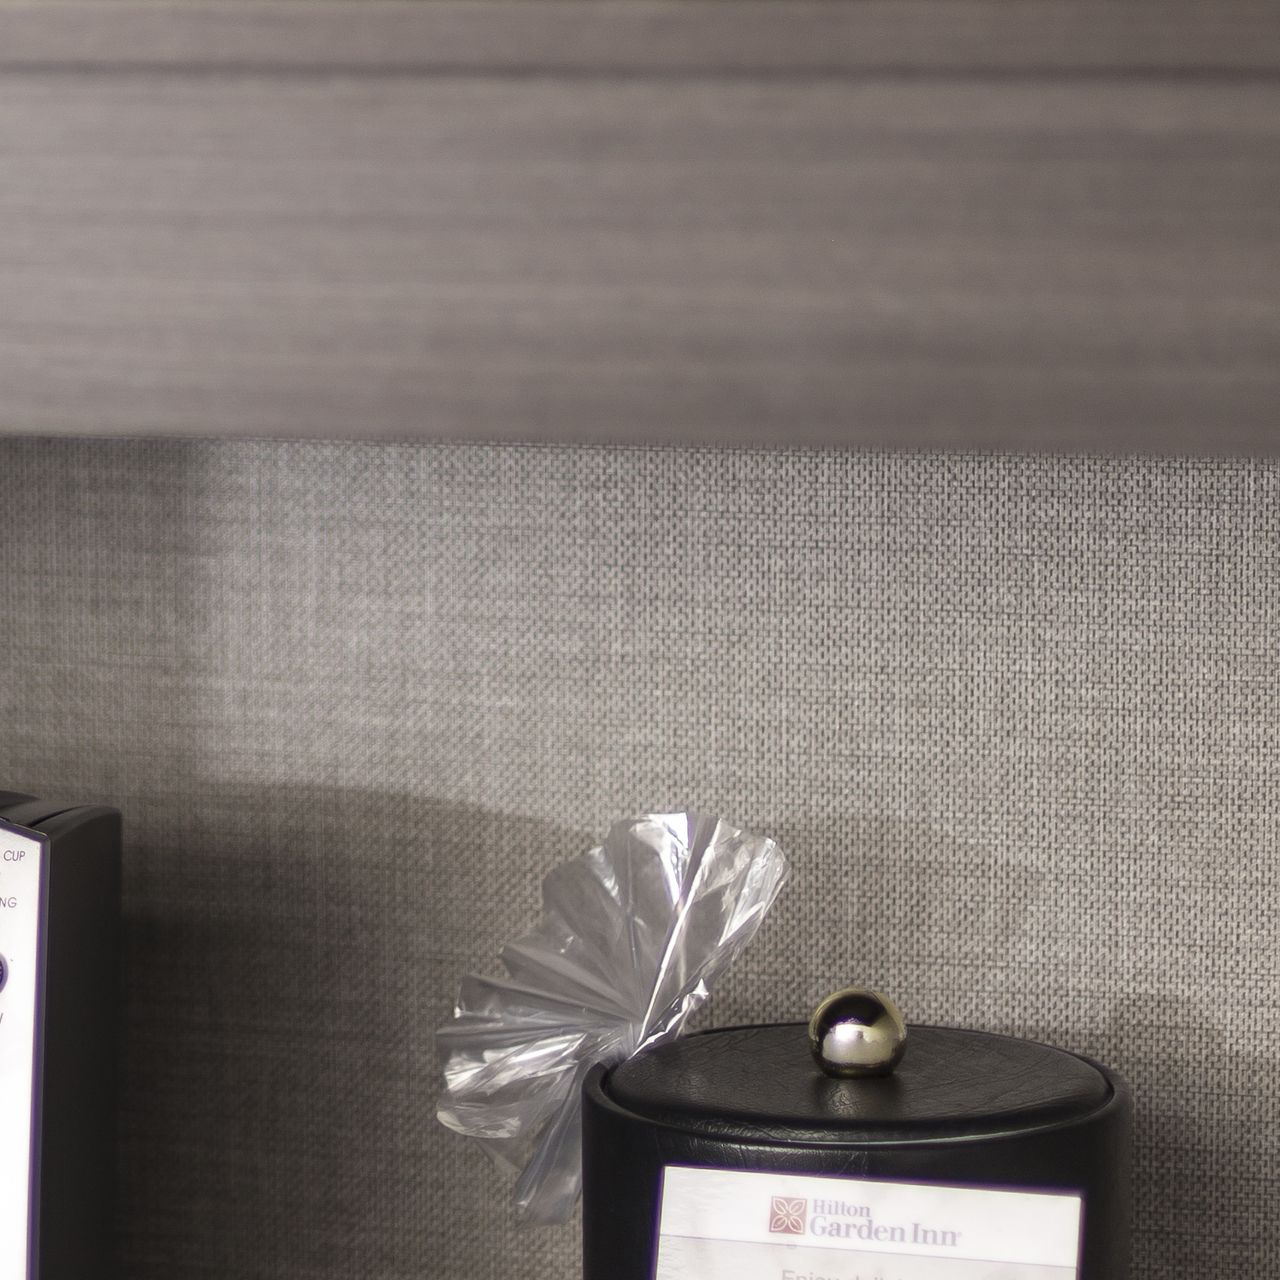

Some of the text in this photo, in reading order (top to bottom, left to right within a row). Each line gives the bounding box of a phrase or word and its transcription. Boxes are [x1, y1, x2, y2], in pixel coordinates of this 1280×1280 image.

[3, 850, 26, 862] CUP
[812, 1198, 871, 1218] Hilton
[809, 1215, 905, 1243] Garden
